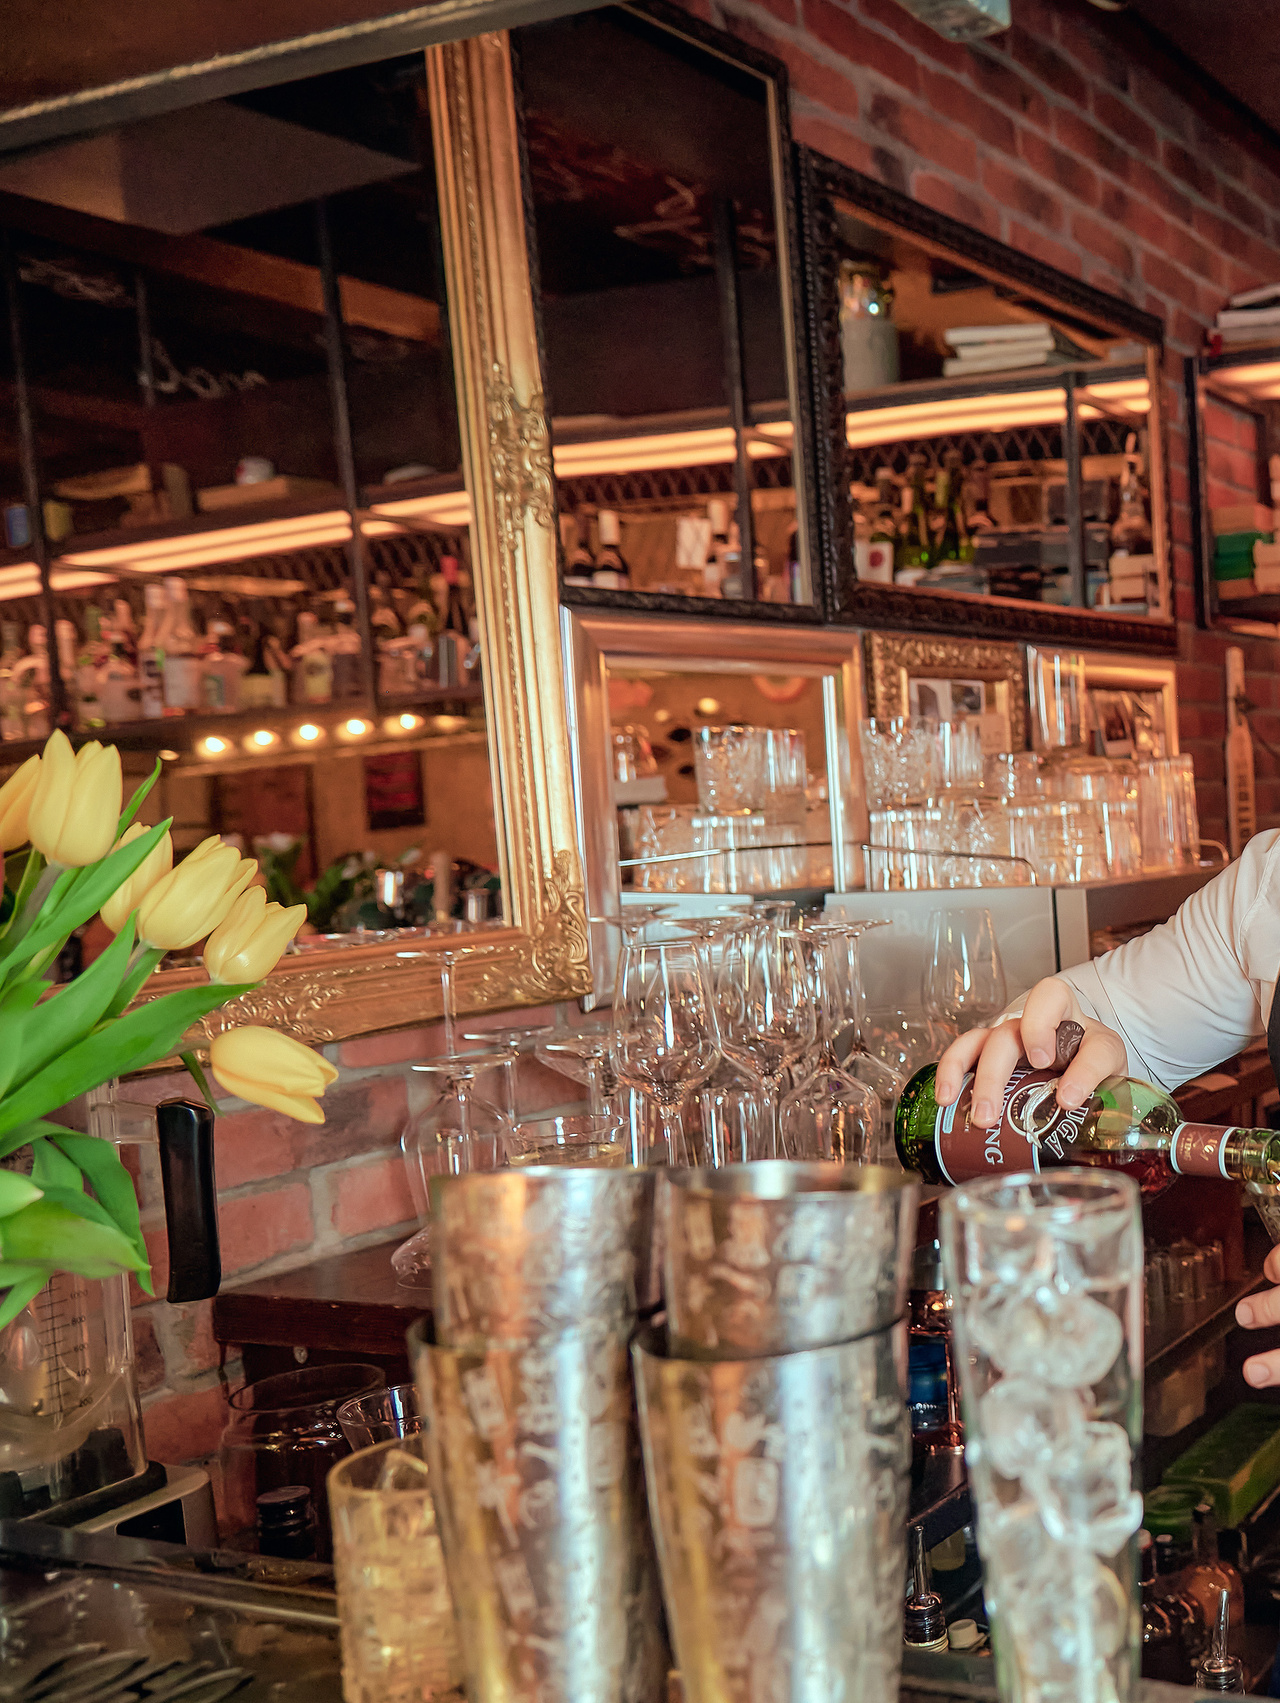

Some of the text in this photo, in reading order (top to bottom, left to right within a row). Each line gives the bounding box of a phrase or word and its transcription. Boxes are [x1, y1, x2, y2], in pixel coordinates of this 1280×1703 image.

[984, 1068, 1036, 1165] UNNG
[1045, 1092, 1094, 1160] UGA
[71, 1315, 87, 1326] 800
